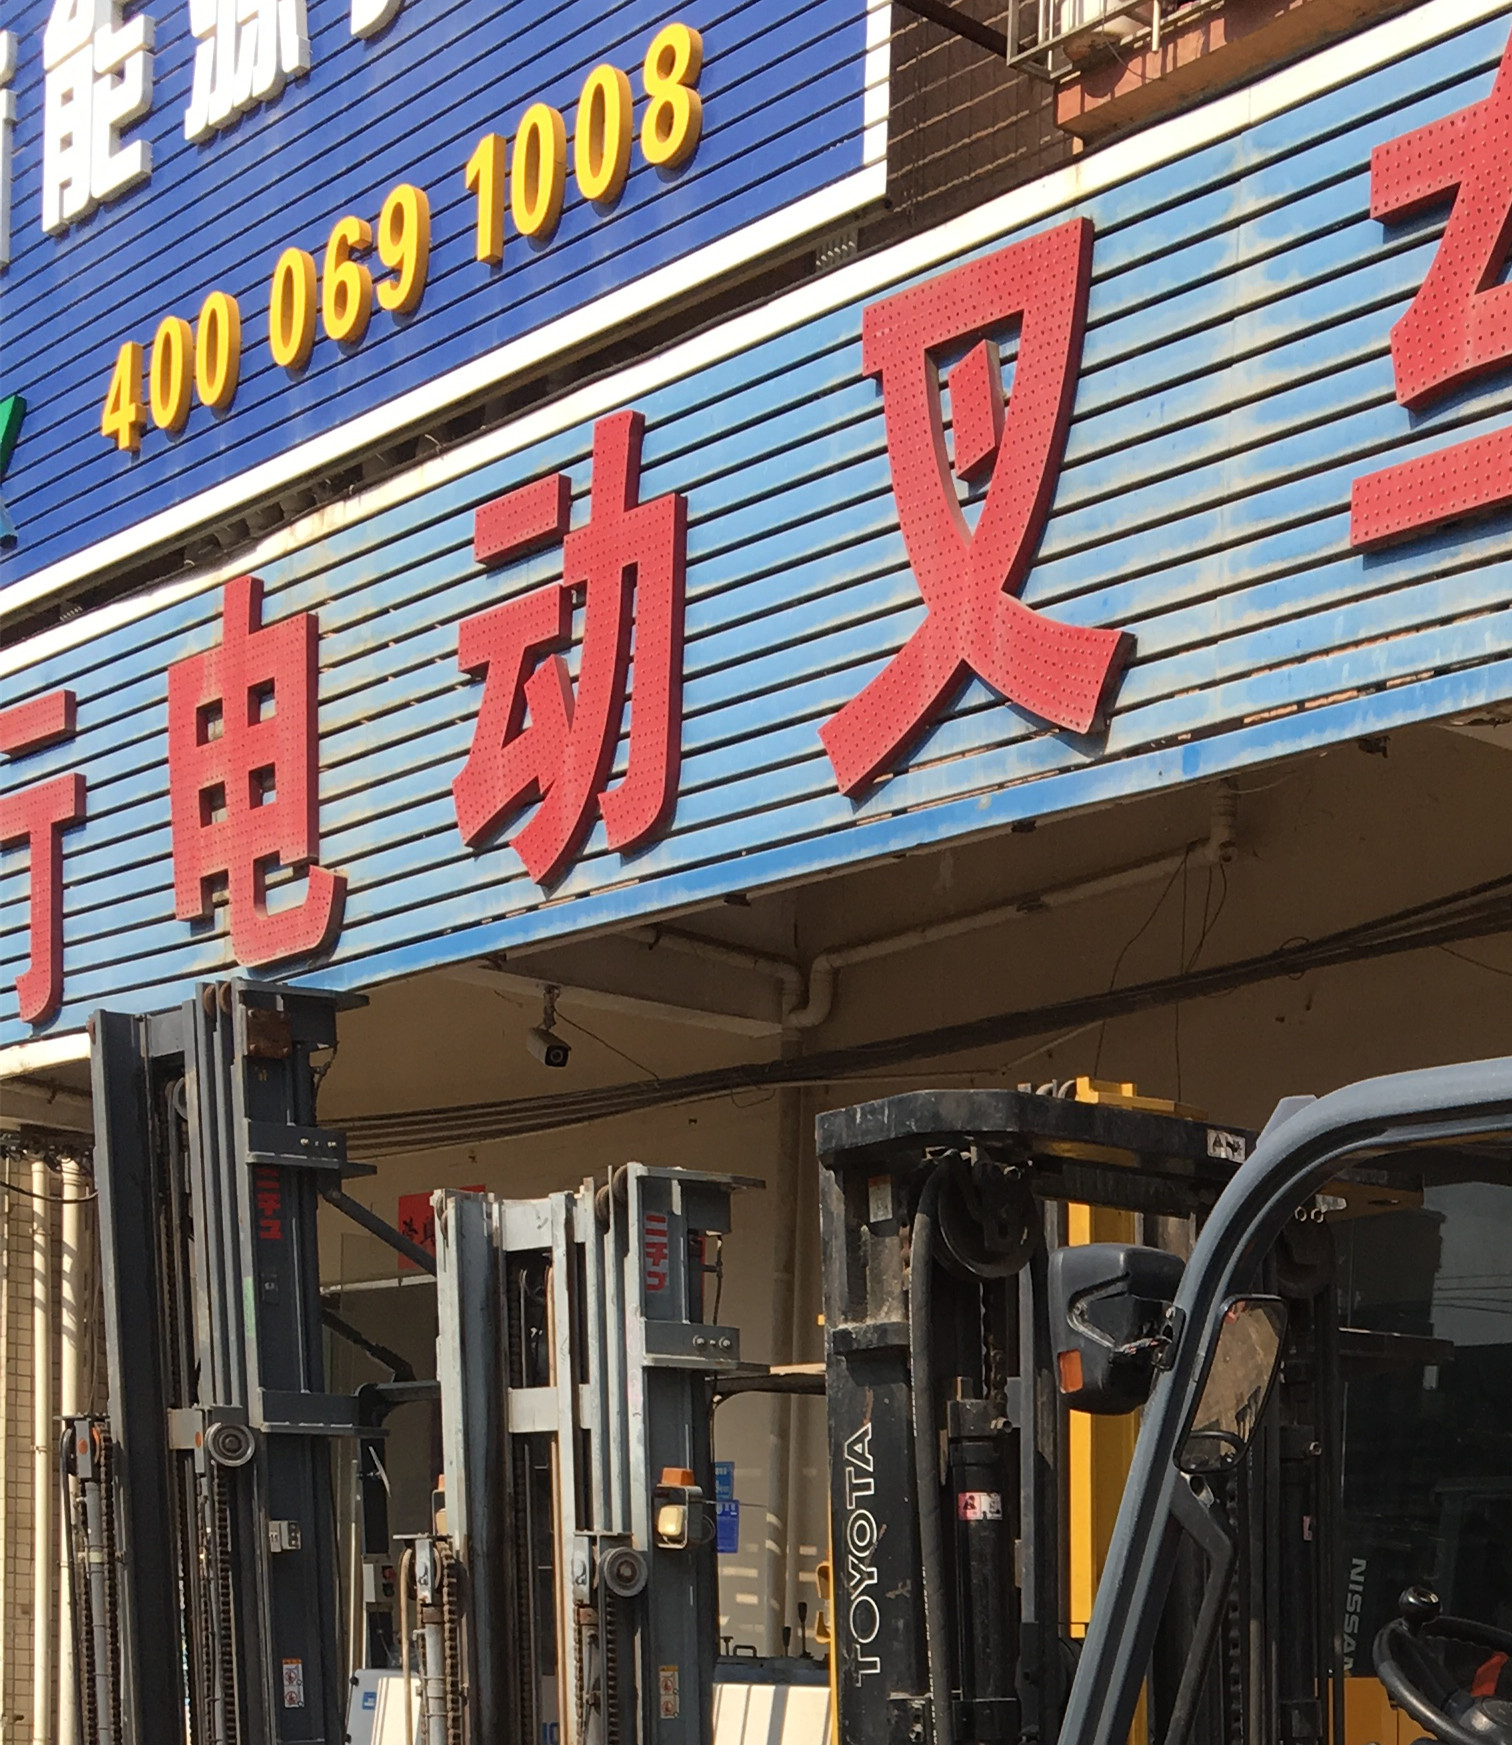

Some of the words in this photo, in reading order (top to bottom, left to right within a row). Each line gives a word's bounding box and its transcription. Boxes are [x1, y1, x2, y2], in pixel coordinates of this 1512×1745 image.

[101, 291, 241, 452] 400
[269, 184, 430, 370] 069
[465, 23, 703, 266] 1008
[843, 1422, 881, 1688] TOYOTA
